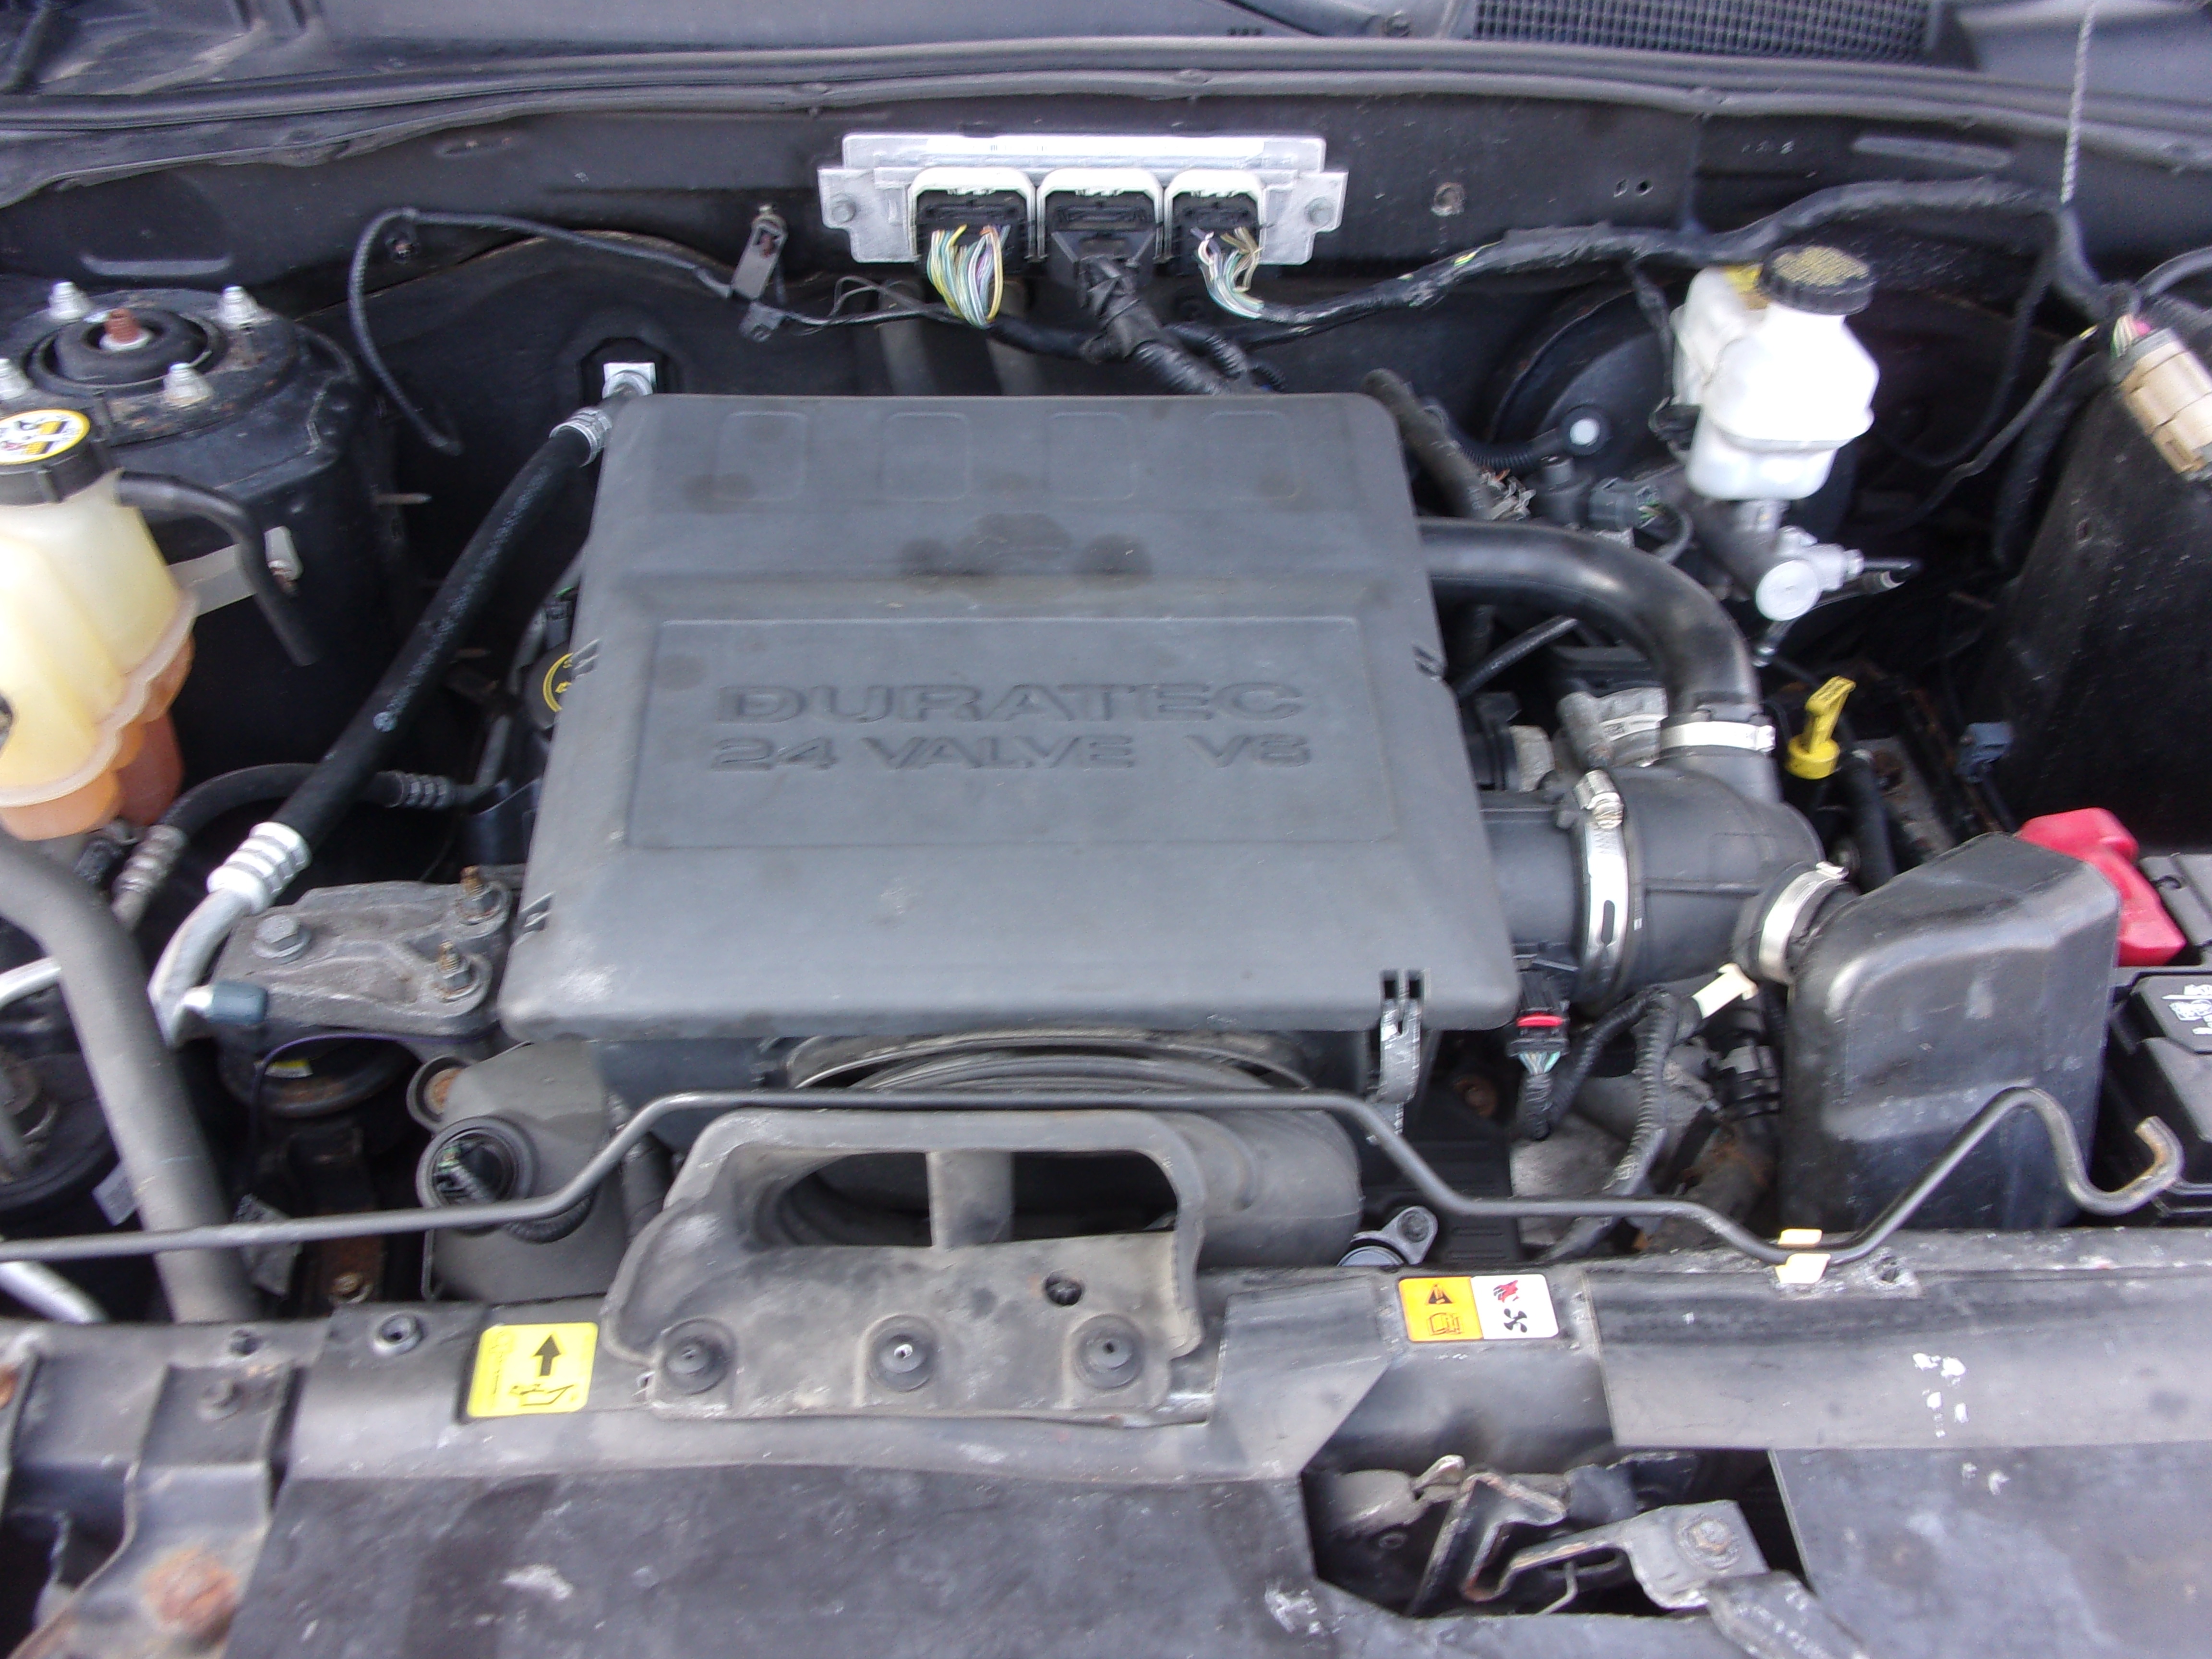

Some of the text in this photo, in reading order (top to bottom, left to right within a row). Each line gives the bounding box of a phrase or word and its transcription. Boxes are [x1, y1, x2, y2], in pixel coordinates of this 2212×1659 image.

[718, 682, 1305, 723] DURATEC
[712, 733, 1312, 772] 24 VALVE V6
